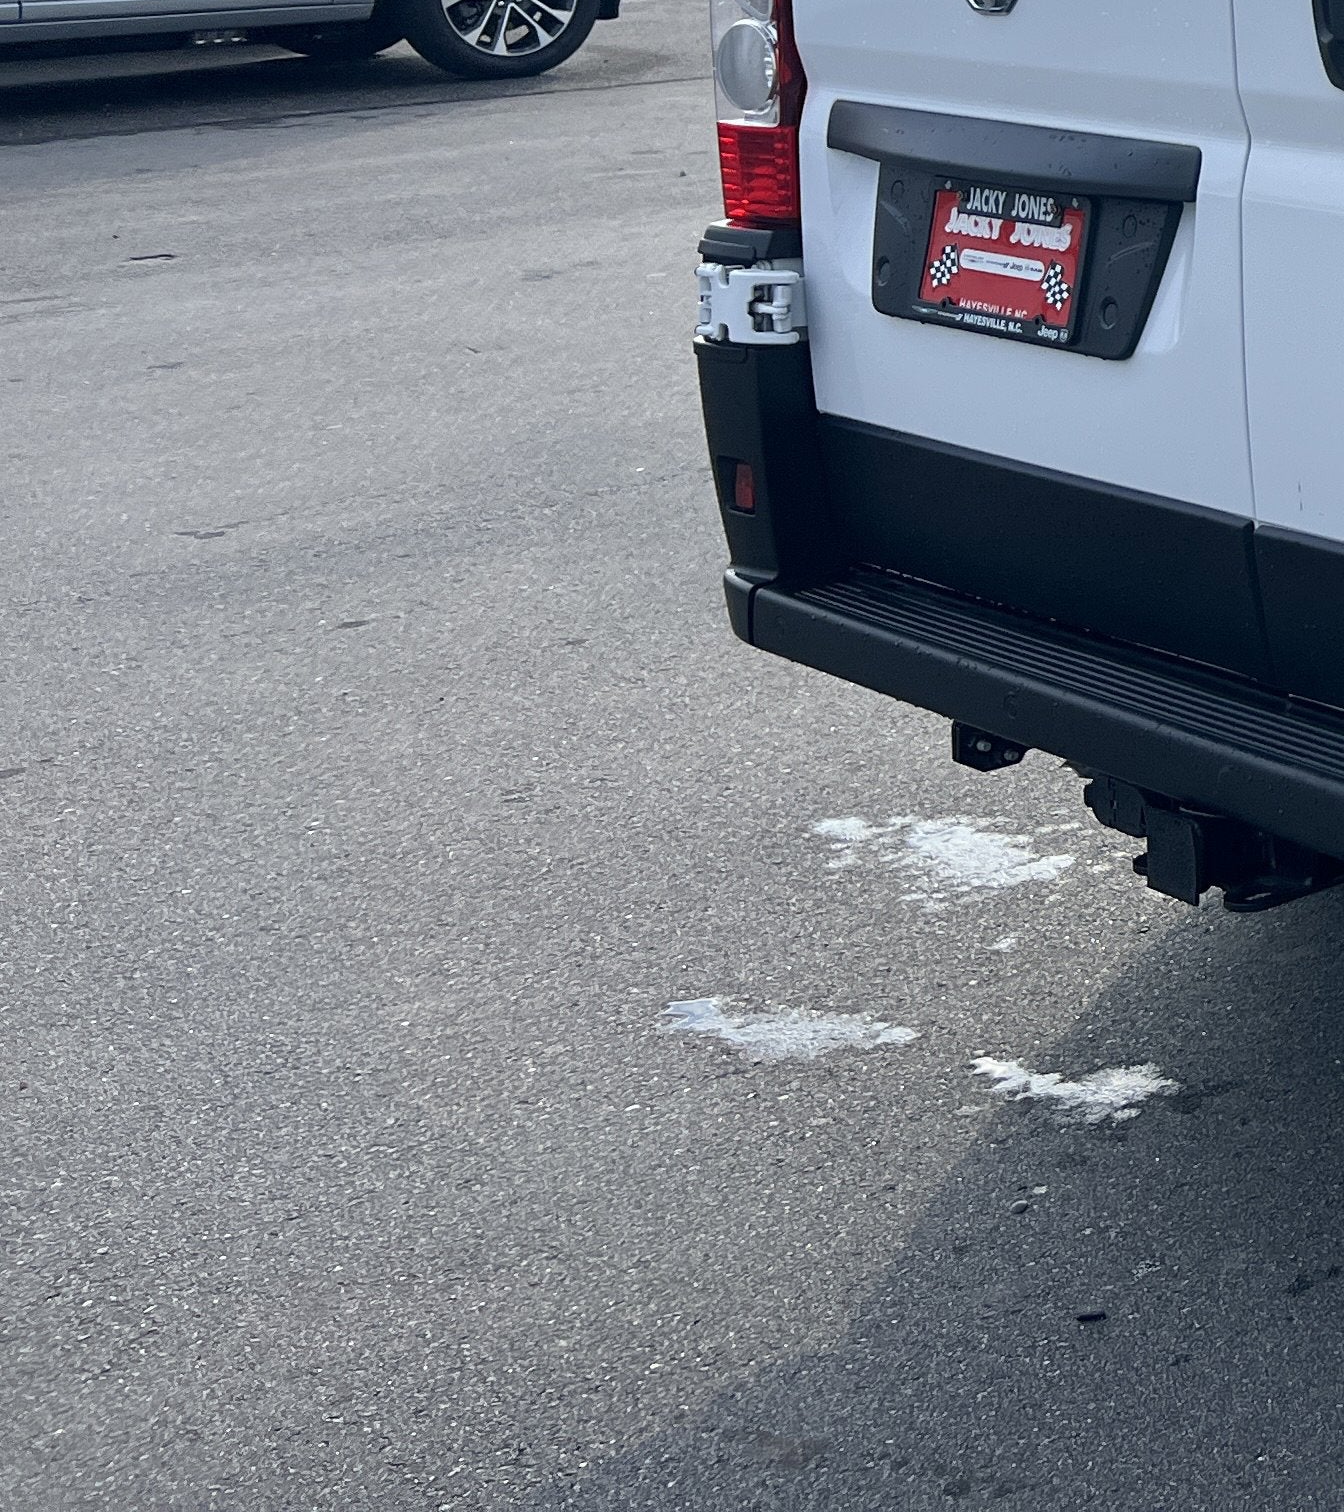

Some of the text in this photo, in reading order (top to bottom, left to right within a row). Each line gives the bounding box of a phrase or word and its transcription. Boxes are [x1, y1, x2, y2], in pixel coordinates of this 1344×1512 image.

[966, 187, 1056, 222] JACKY JONES
[945, 207, 1073, 252] JACKY JONES
[963, 313, 1007, 332] HAYESVILLE,
[1008, 322, 1023, 333] N.C.
[1037, 324, 1059, 341] Jeep
